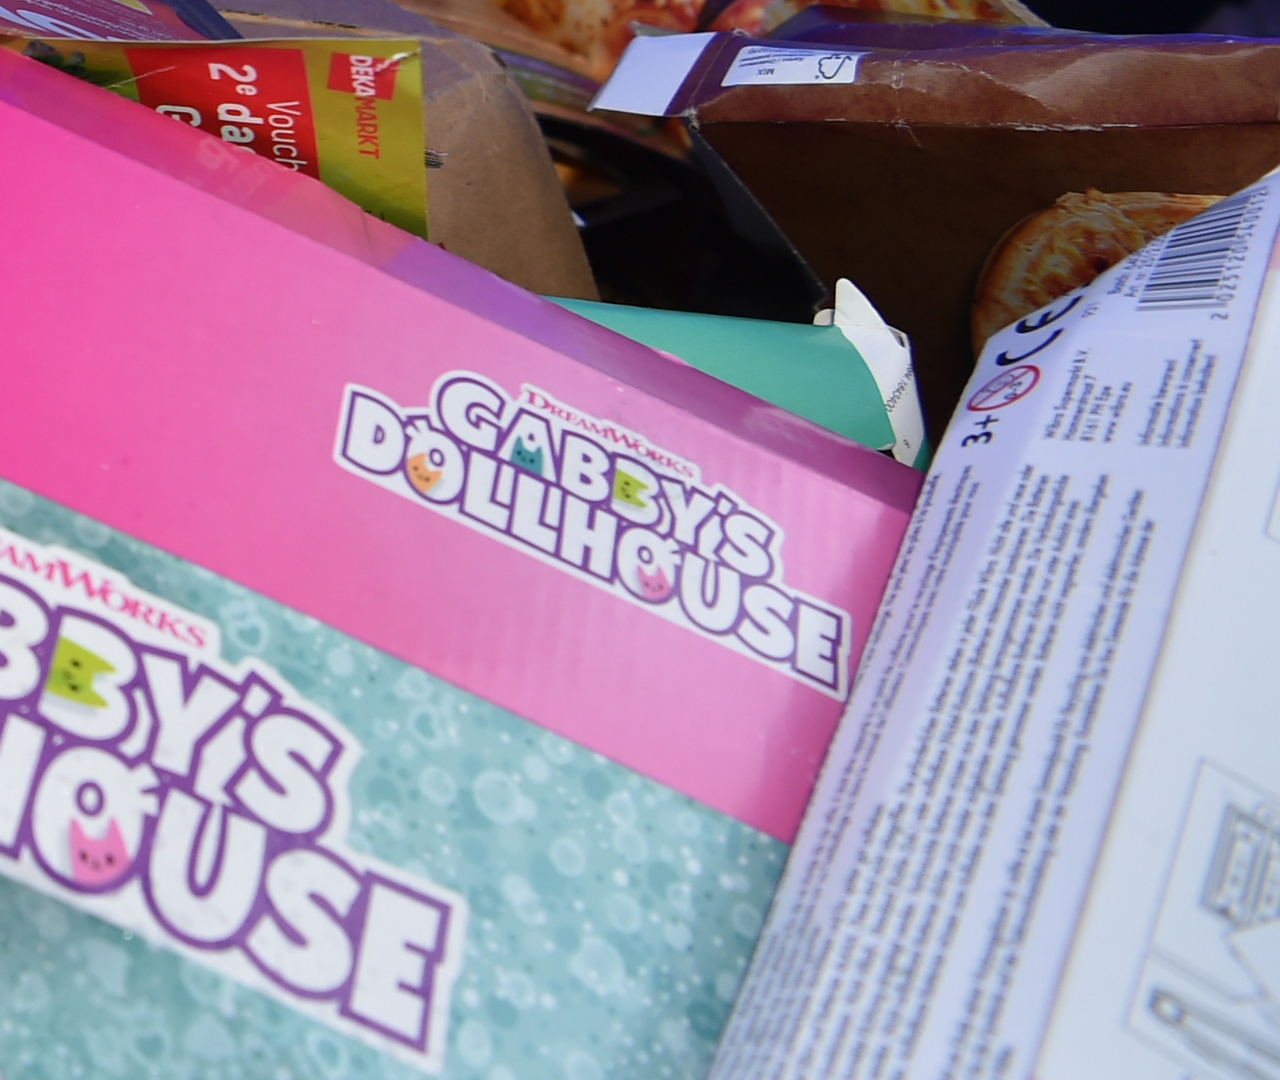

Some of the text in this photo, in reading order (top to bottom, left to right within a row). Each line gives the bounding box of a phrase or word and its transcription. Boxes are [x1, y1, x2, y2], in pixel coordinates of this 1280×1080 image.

[208, 62, 258, 96] 2e
[348, 54, 380, 160] DEKAMARKT
[1210, 309, 1229, 323] 2
[521, 388, 696, 479] DREAMWORKS
[961, 413, 1000, 448] 3+
[434, 376, 777, 579] GABBY'S
[342, 390, 845, 692] DOLLHOUSE
